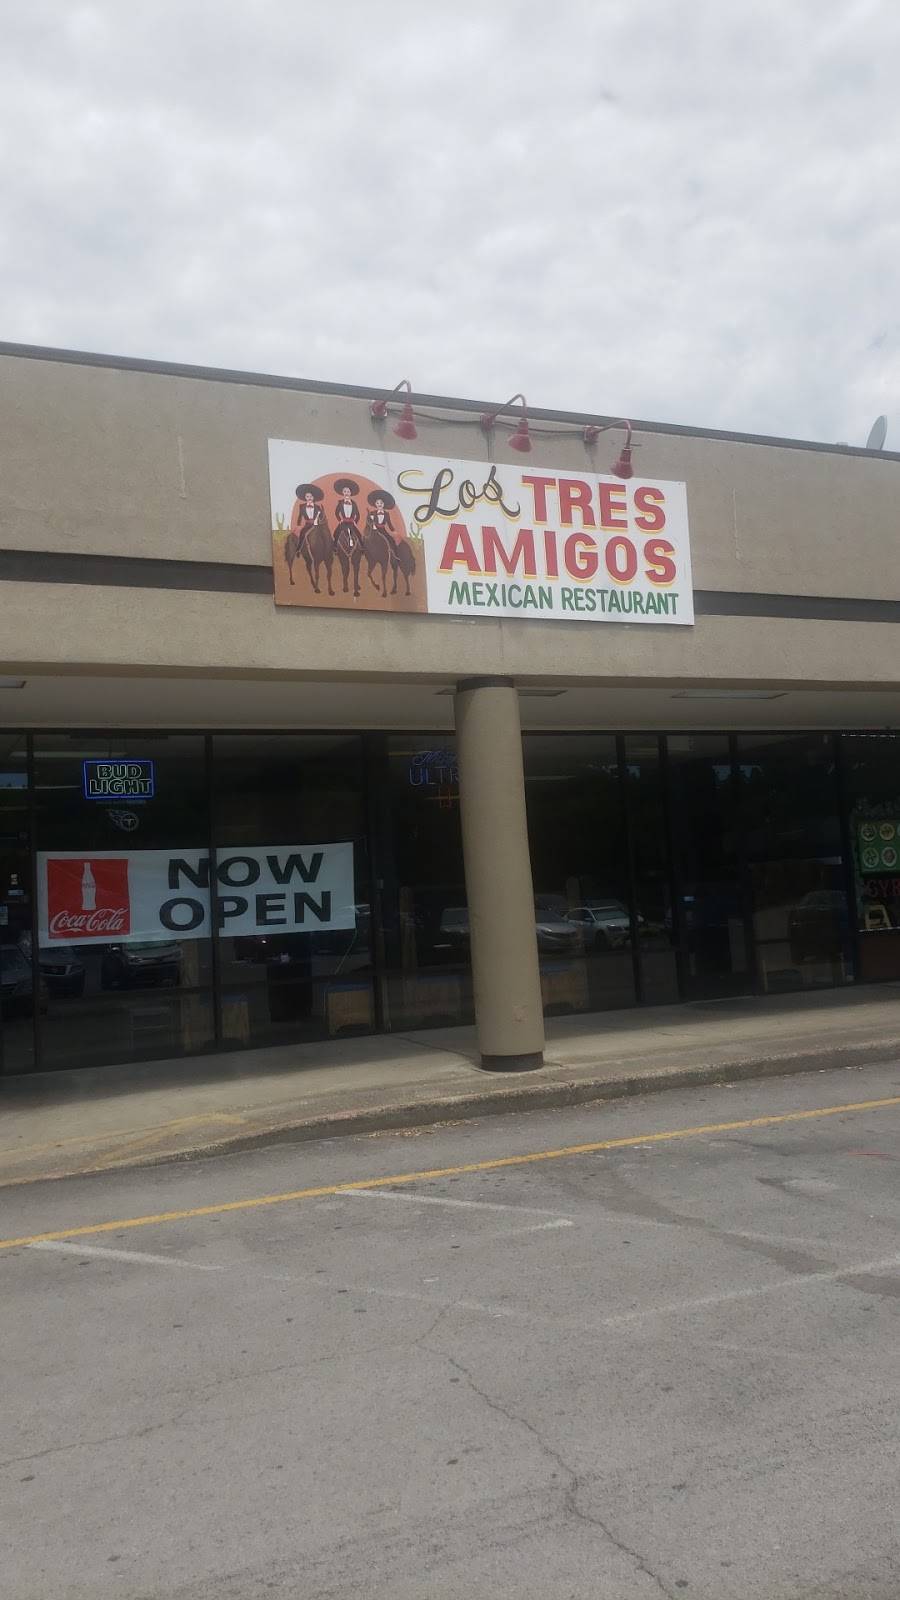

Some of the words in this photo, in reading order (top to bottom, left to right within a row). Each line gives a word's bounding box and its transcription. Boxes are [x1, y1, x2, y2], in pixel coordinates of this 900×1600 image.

[397, 465, 521, 524] Los
[521, 475, 668, 532] TRES
[437, 523, 678, 586] AMIGOS
[448, 580, 554, 610] MEXICAN
[561, 587, 680, 616] RESTAURANT
[89, 778, 152, 795] LIGHT
[96, 764, 142, 780] BUD
[409, 767, 461, 786] ULTR
[168, 852, 324, 889] NOW
[159, 891, 332, 932] OPEN
